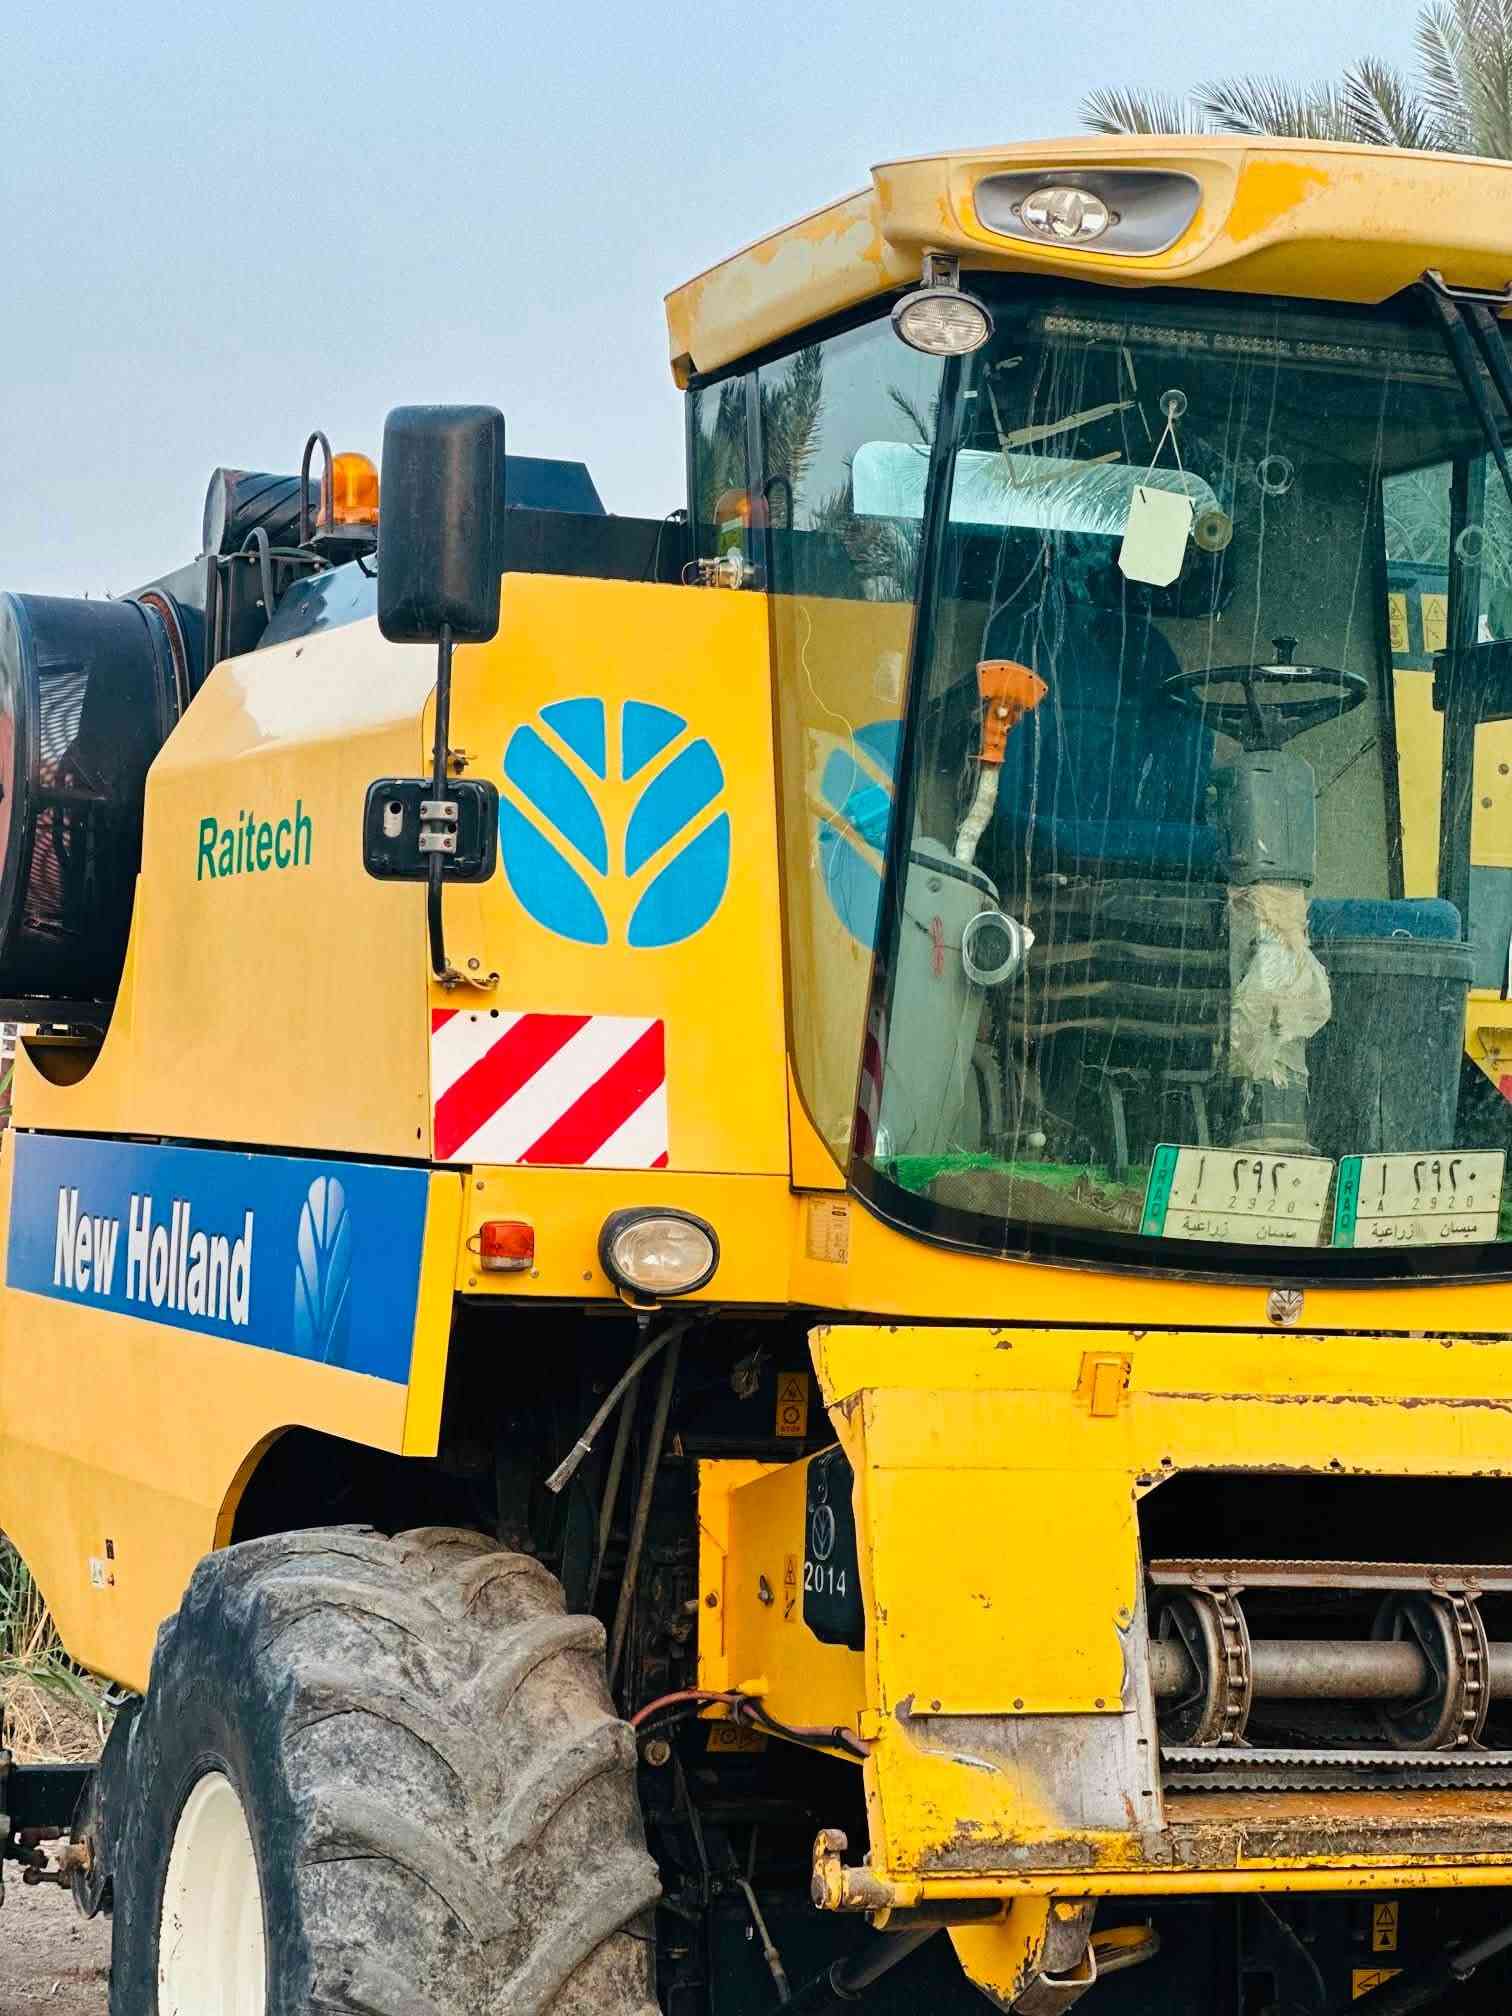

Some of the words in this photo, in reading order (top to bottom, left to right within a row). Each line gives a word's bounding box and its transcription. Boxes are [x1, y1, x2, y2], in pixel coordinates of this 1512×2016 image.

[197, 799, 312, 881] Raitech
[1412, 1195, 1474, 1210] 2920
[1371, 1221, 1415, 1242] زراعية
[1440, 1219, 1478, 1239] ميسان
[53, 1185, 119, 1296] New
[126, 1193, 254, 1326] Holland
[804, 1561, 846, 1598] 2014
